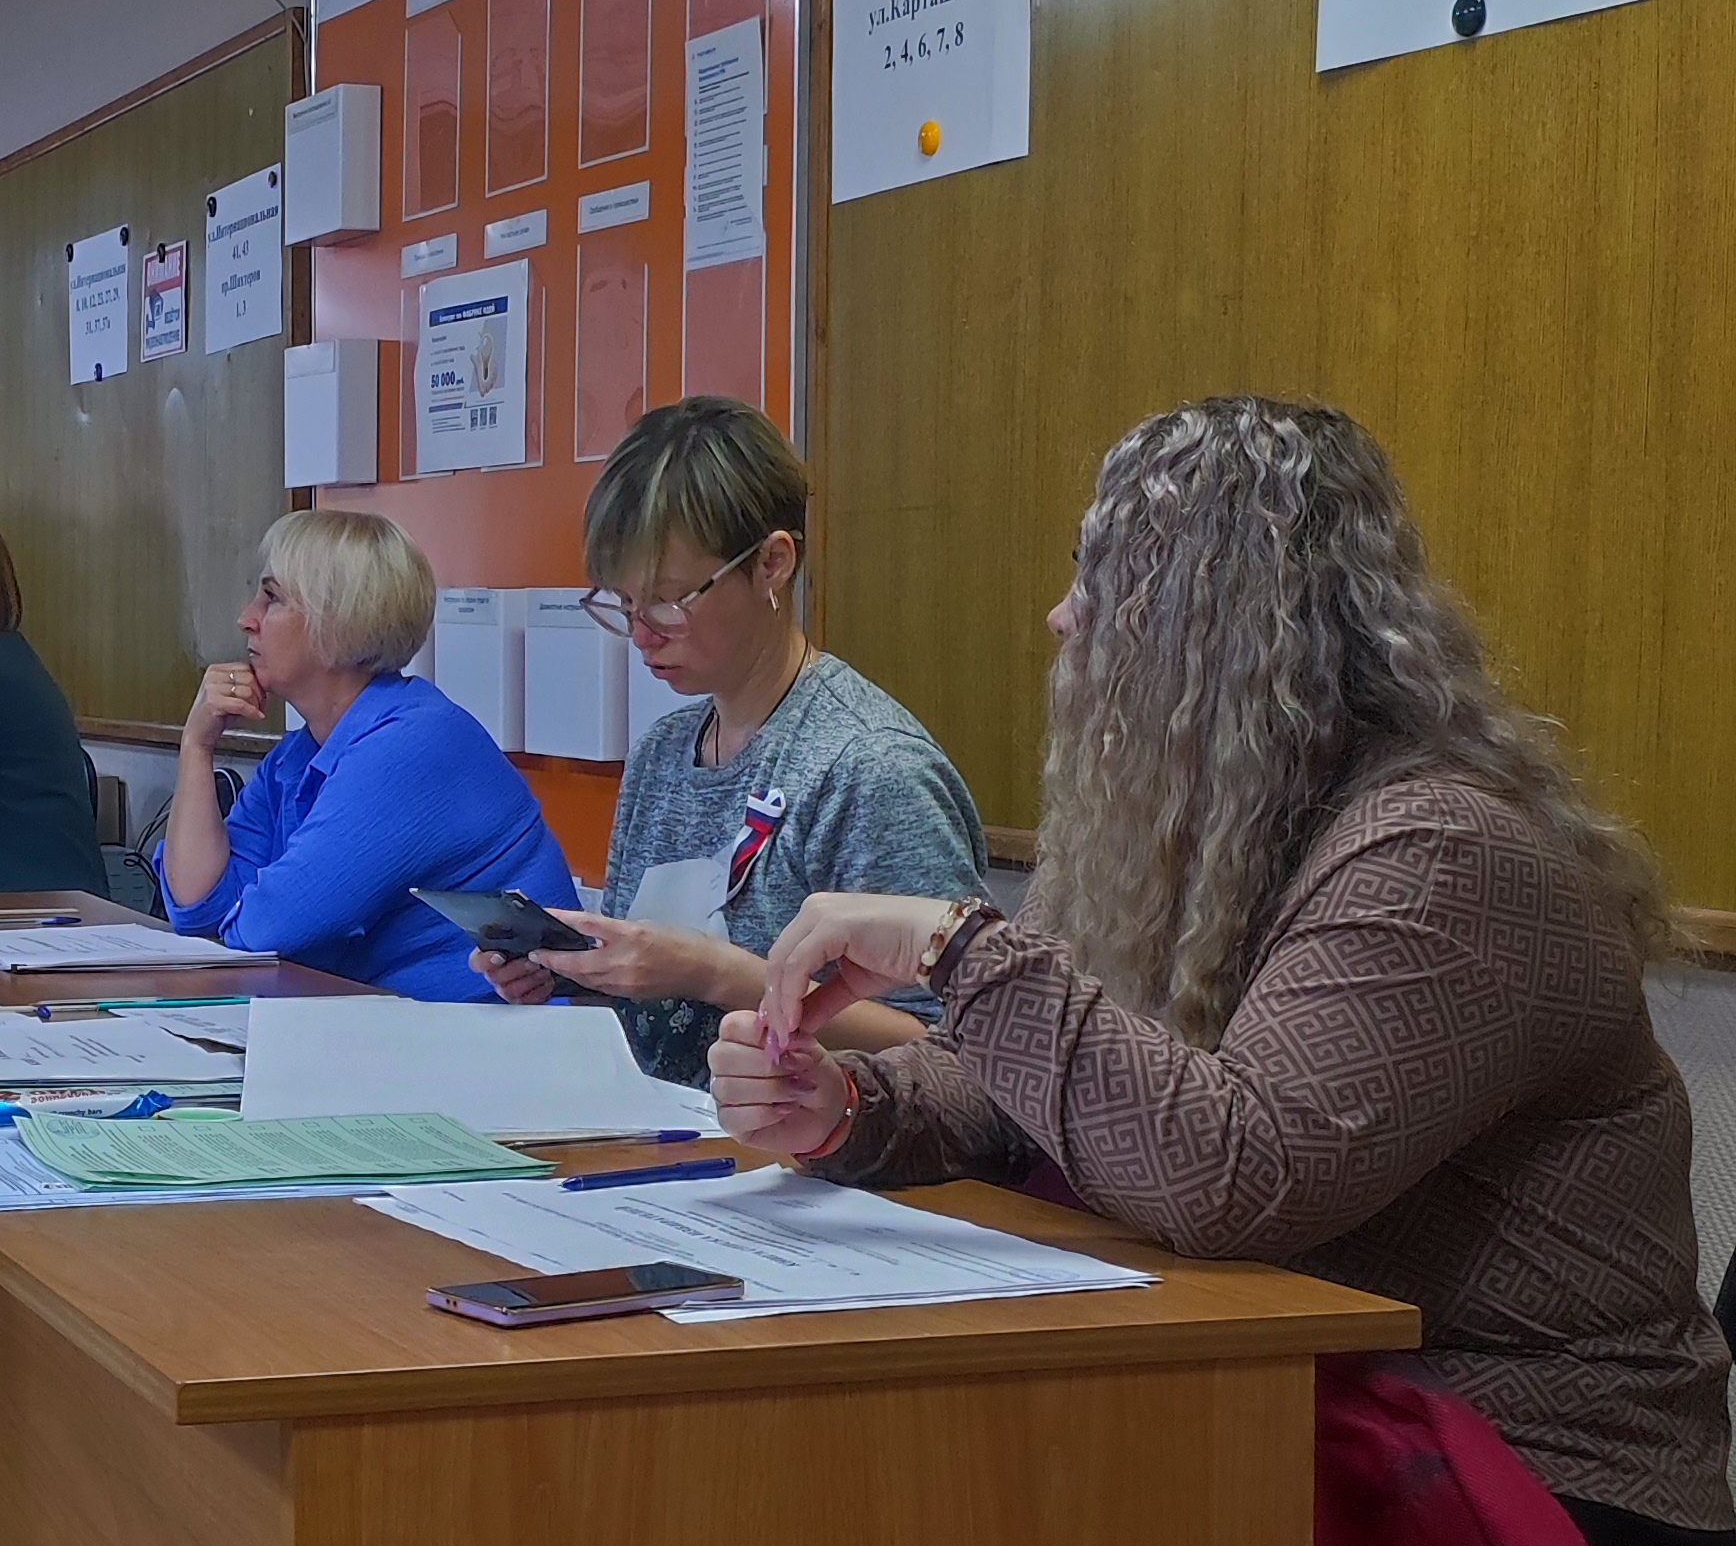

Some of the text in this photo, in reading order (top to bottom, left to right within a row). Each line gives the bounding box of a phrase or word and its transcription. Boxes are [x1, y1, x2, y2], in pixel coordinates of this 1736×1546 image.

[884, 21, 965, 71] 2, 4, 6, 7, 8
[430, 373, 440, 389] 50
[440, 370, 456, 386] 000
